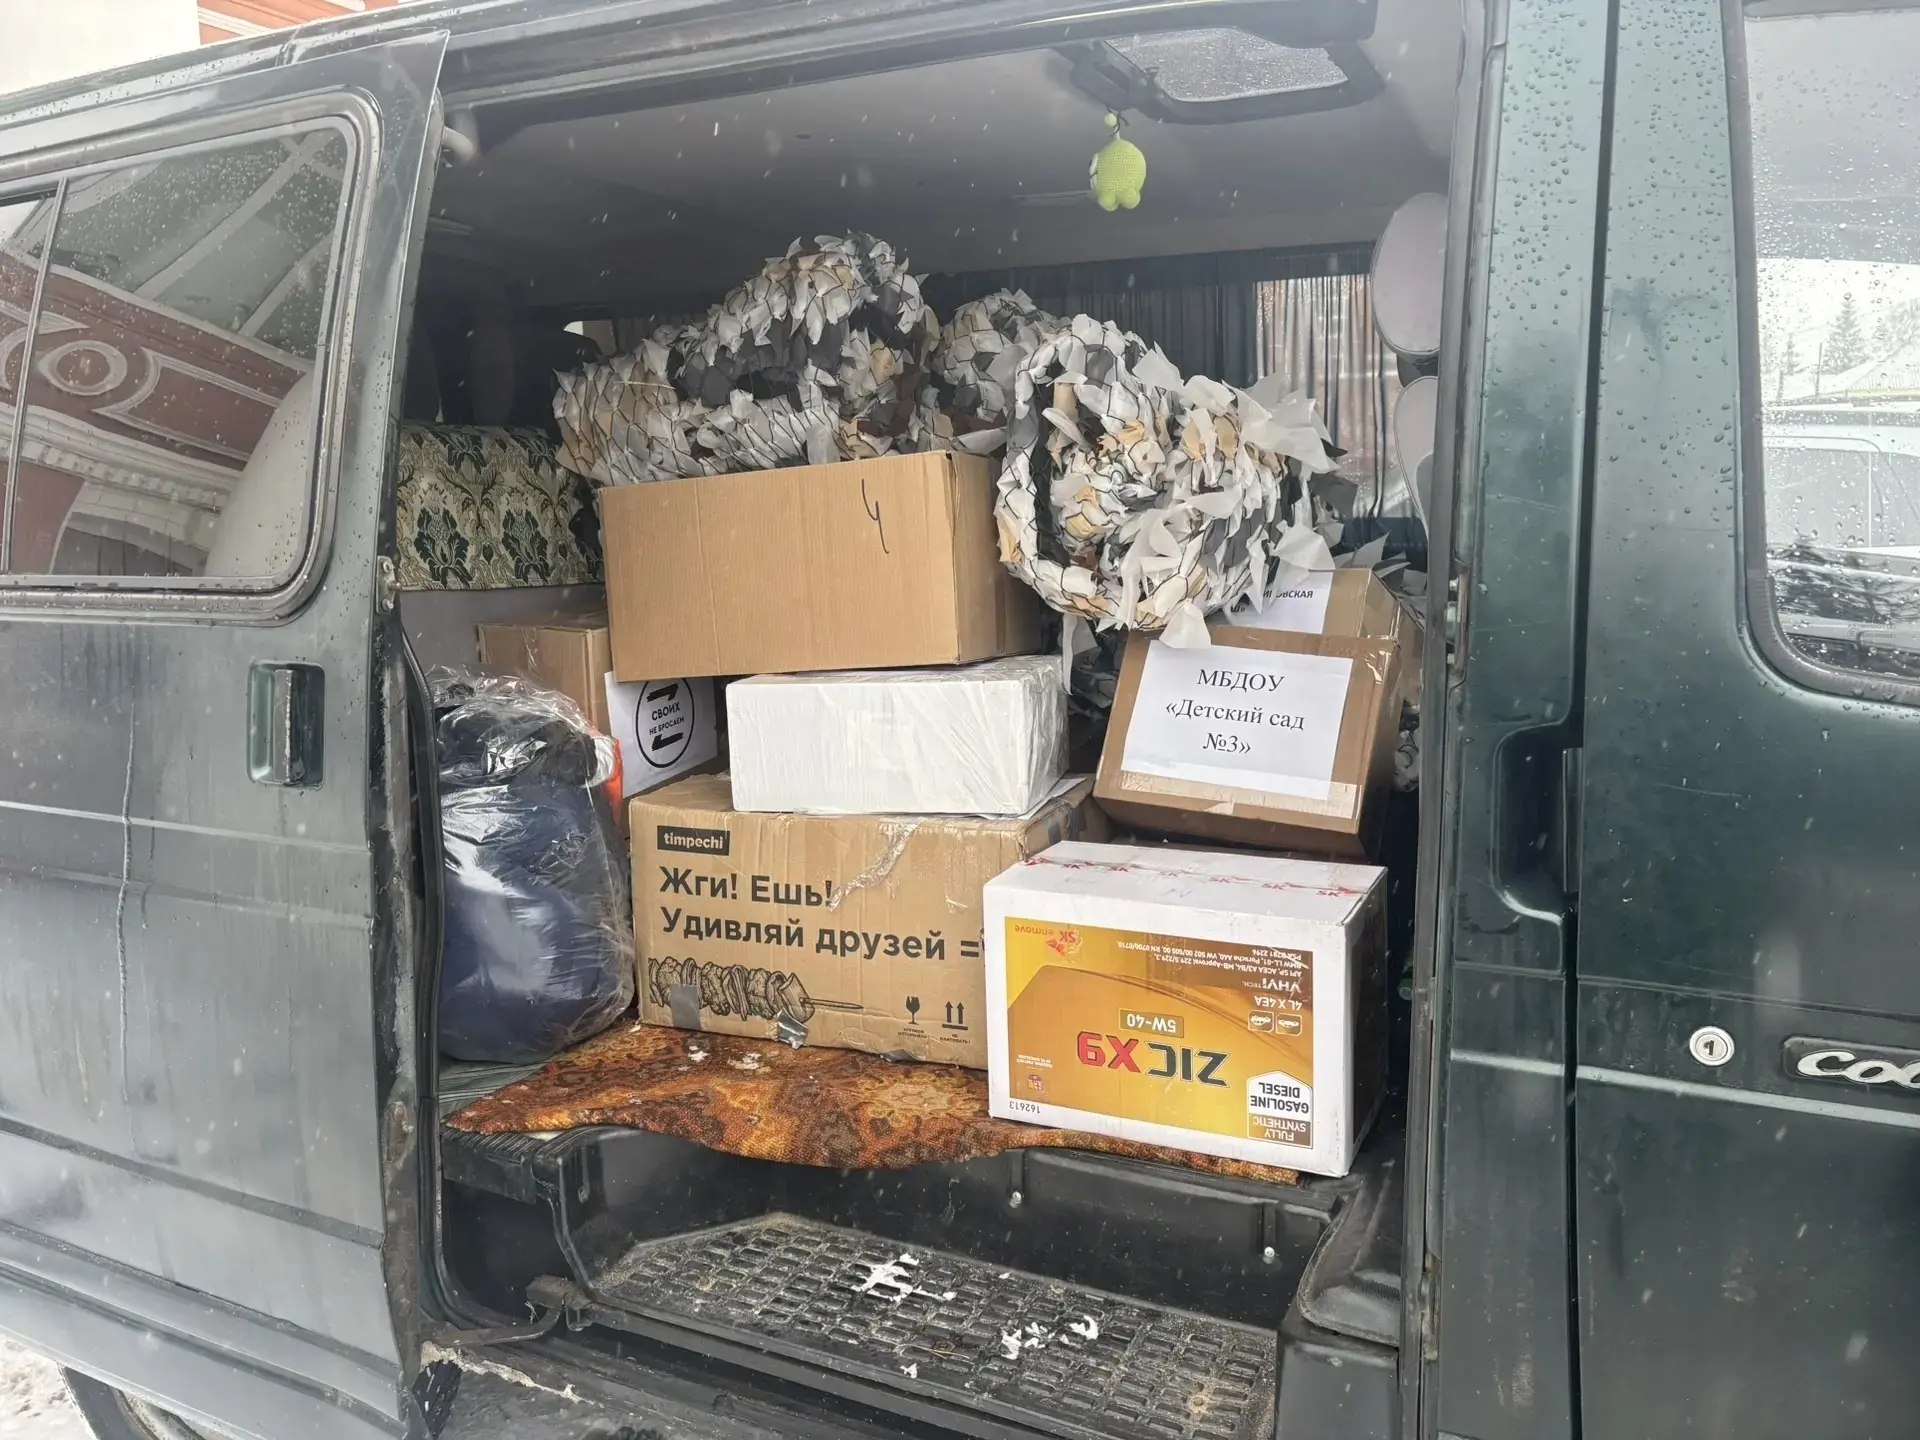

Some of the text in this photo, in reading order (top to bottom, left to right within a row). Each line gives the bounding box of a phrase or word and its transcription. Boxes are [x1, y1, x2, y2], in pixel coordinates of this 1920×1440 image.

[1197, 668, 1285, 692] МБДОУ
[651, 702, 681, 721] СВОИХ
[1165, 698, 1305, 731] «Детский сад
[649, 715, 685, 736] НЕ БРОСАЕМ
[1202, 732, 1251, 755] №3»
[663, 831, 724, 850] timpechi
[659, 865, 833, 907] Жги! Ешь!
[660, 906, 804, 948] Удивляй
[815, 928, 945, 961] друзей
[1014, 924, 1076, 943] SK enmove
[1233, 955, 1260, 965] Porsche
[1254, 995, 1303, 1011] 4L X 4EA
[1126, 1013, 1177, 1034] 5W-40
[1258, 1082, 1301, 1099] DIESEL
[1009, 1100, 1041, 1114] 162613
[1250, 1095, 1310, 1114] GASOLINE
[1252, 1115, 1307, 1133] SYNTHETIC
[1264, 1128, 1295, 1142] FULLY
